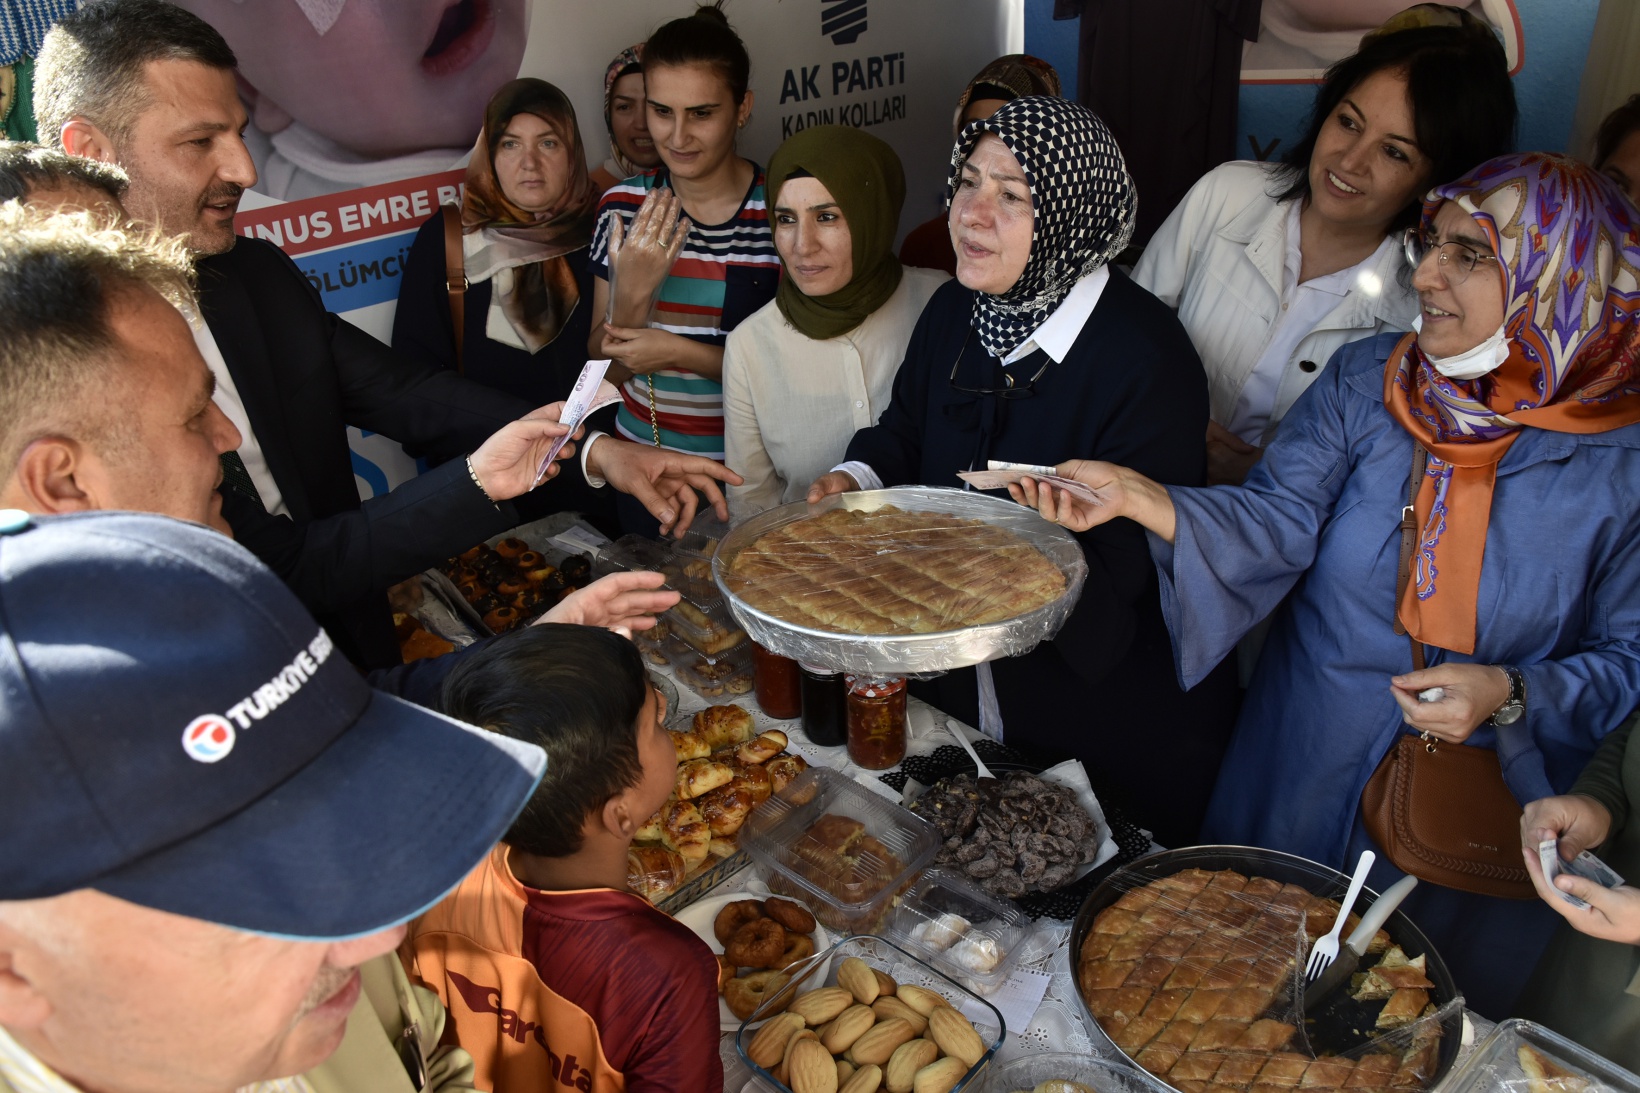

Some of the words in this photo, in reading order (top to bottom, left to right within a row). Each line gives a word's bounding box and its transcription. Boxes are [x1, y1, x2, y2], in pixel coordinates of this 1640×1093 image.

[779, 64, 821, 105] AK
[839, 94, 906, 129] KOLLARI
[338, 189, 432, 233] EMRE
